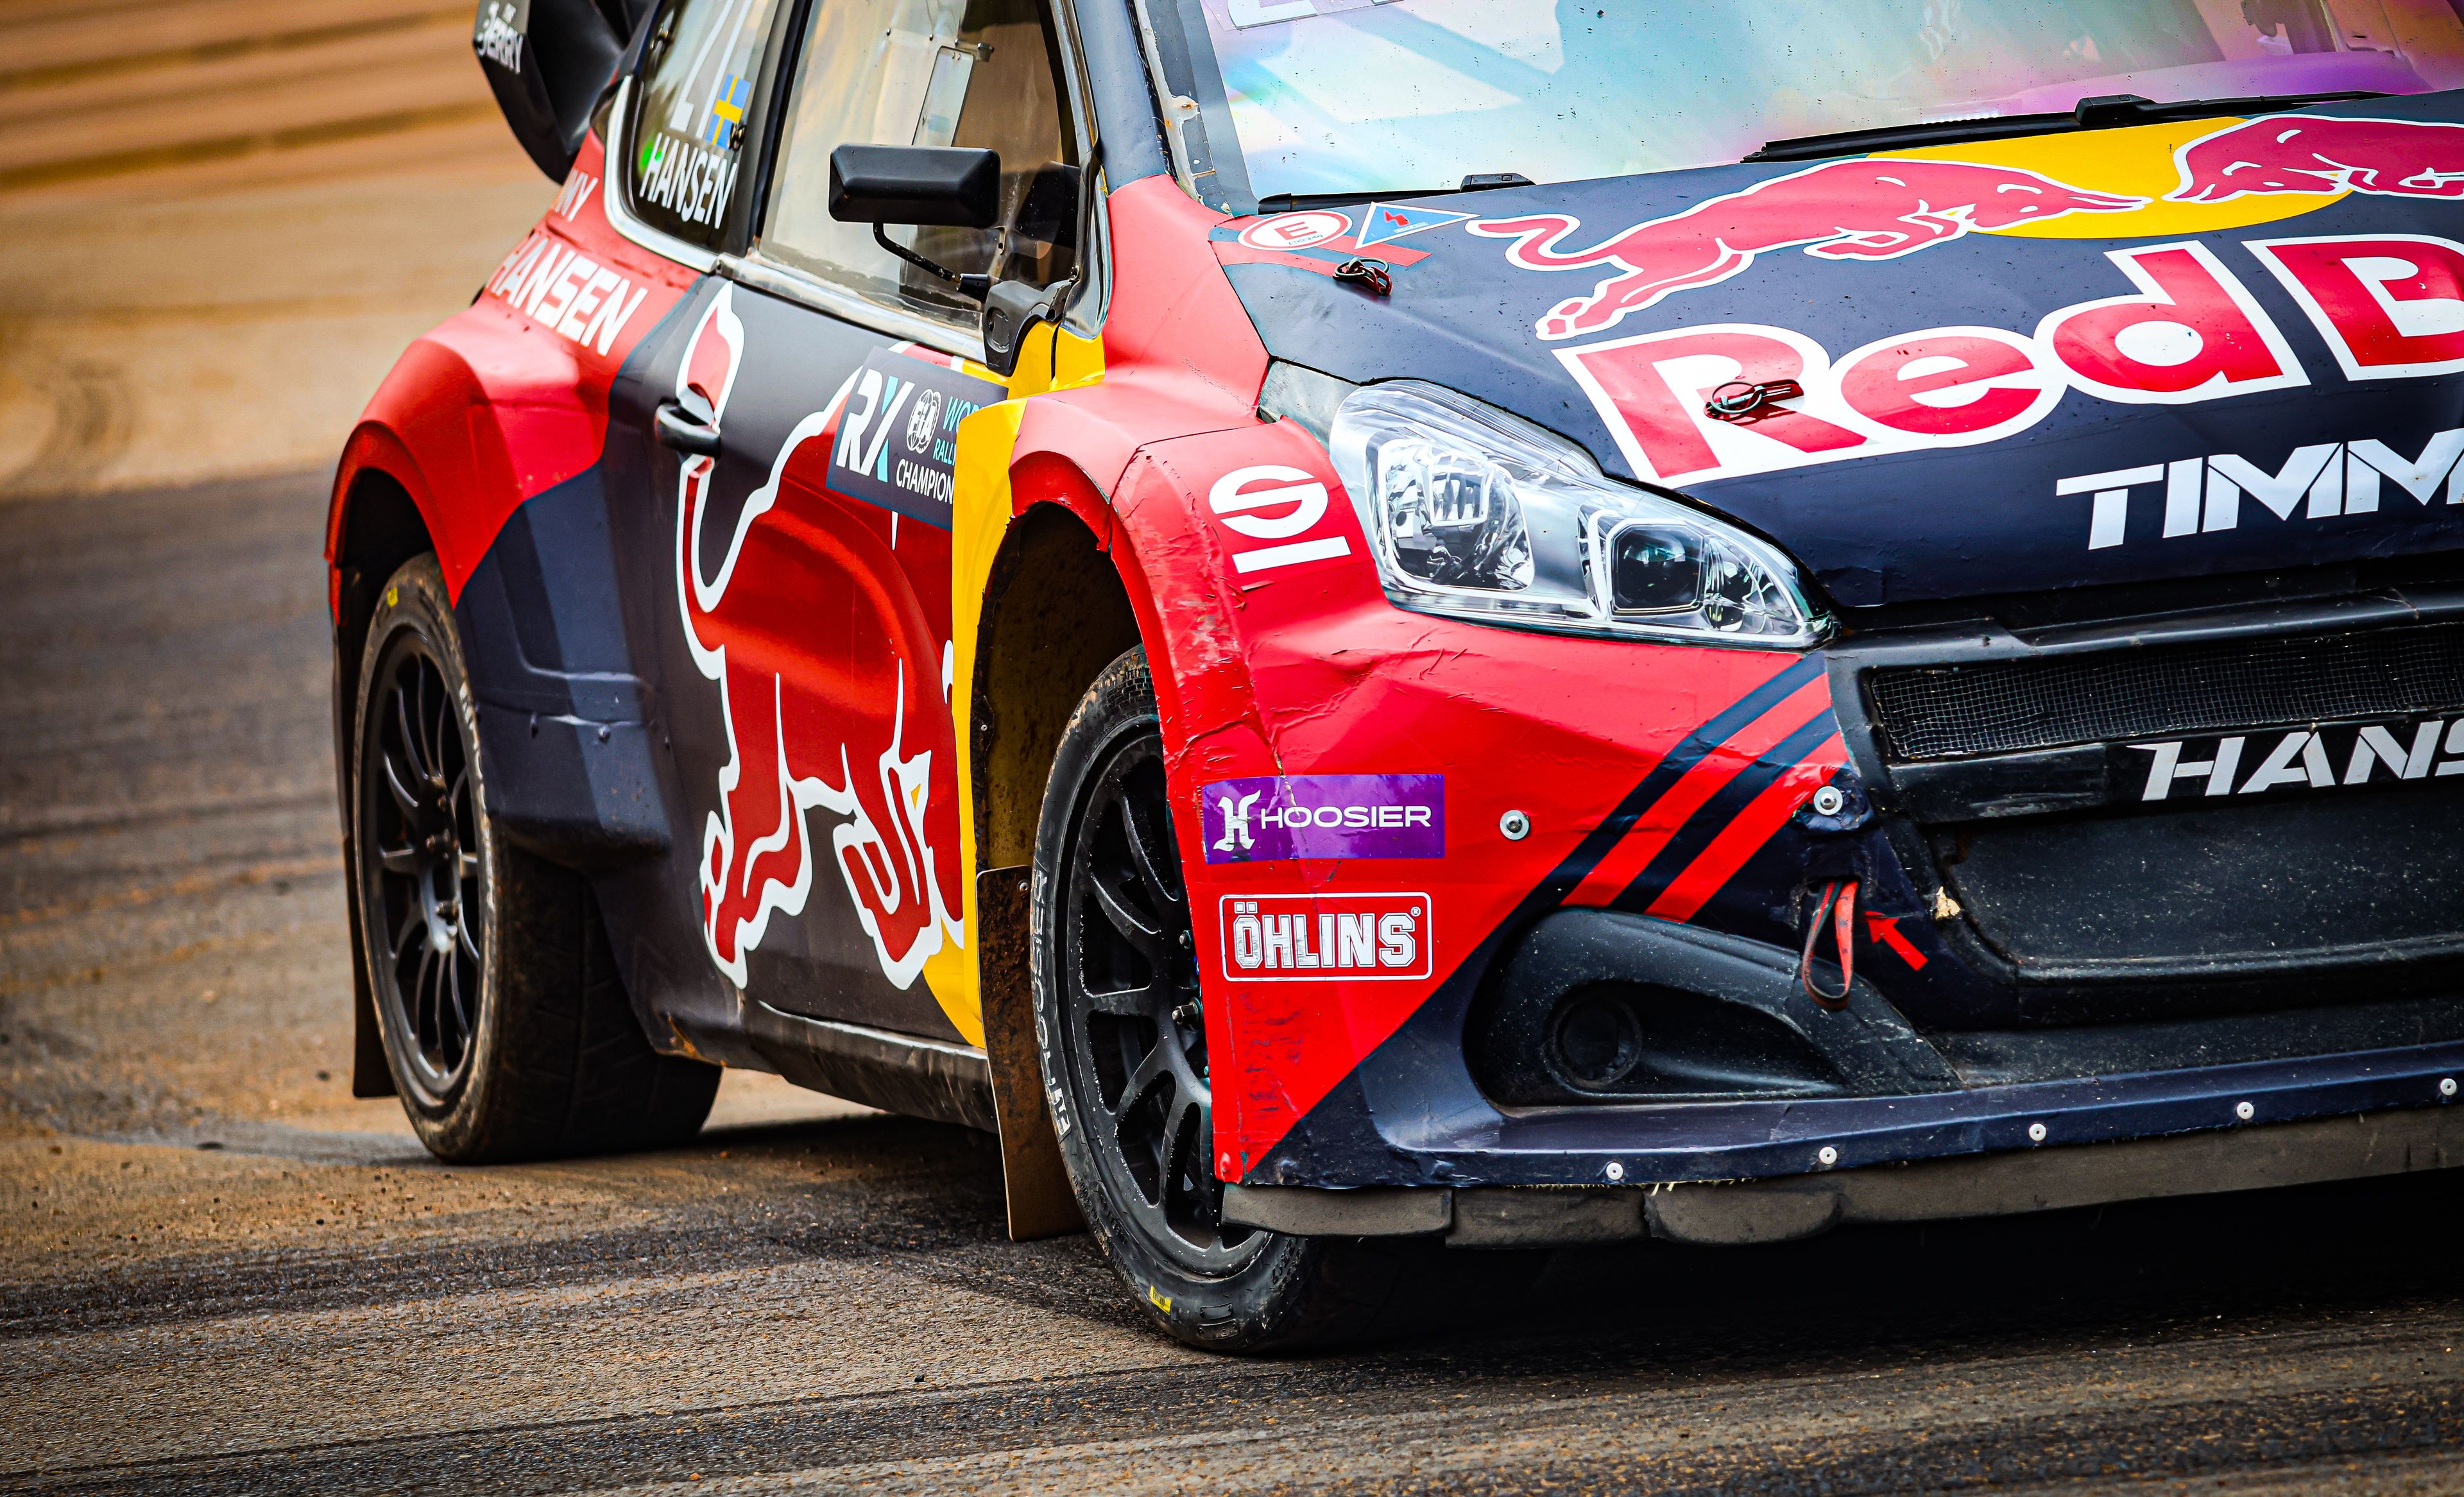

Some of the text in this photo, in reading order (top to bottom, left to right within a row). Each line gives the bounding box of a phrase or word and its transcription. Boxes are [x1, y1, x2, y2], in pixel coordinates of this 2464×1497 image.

[639, 132, 738, 229] HANSEN
[486, 232, 648, 357] HANSEN
[1552, 240, 2311, 486] Red
[835, 368, 915, 483] RX
[896, 458, 955, 505] CHAMPION
[2056, 428, 2464, 551] TIMM
[1260, 805, 1432, 829] HOOSIER
